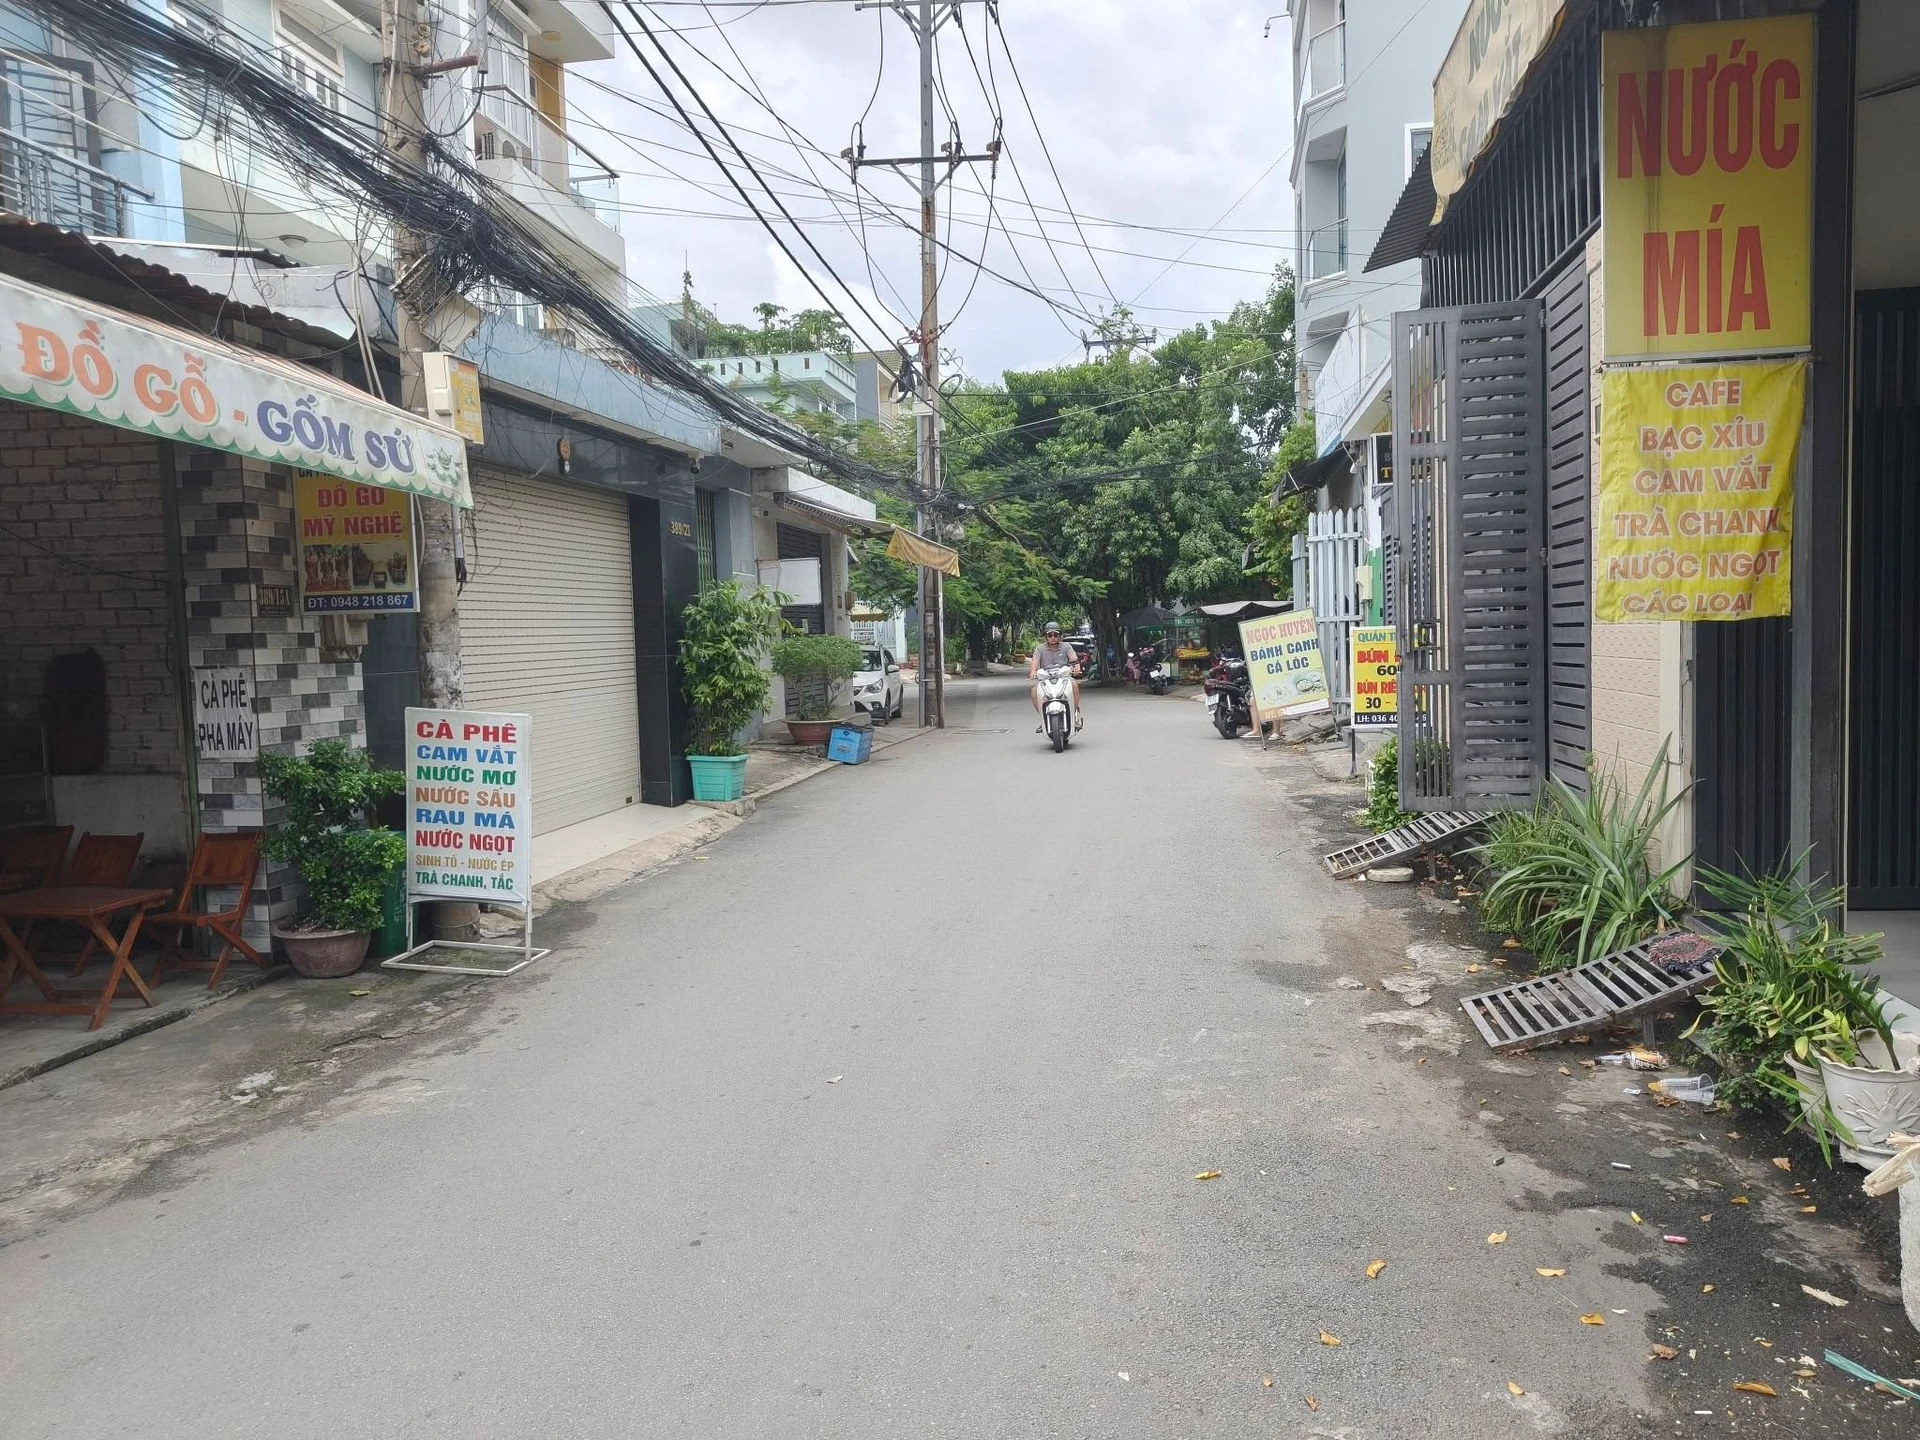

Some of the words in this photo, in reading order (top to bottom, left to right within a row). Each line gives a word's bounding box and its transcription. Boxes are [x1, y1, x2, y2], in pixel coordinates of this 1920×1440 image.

[1617, 39, 1800, 179] NƯỚC
[1643, 204, 1771, 338] MÍA
[16, 319, 115, 397] ĐỒ
[134, 352, 217, 424] GỖ
[257, 394, 355, 461] GỐM
[365, 427, 415, 473] SỨ
[1666, 380, 1741, 407] CAFE
[1641, 426, 1703, 458] BẠC
[1712, 416, 1766, 449] XỈU
[1634, 468, 1704, 494] CAM
[1714, 455, 1772, 491] VẮT
[317, 482, 348, 508] ĐỒ
[304, 514, 336, 537] MỸ
[343, 511, 403, 538] NGHỆ
[1614, 506, 1670, 537] TRÀ
[1679, 508, 1780, 536] CHANH
[1609, 548, 1698, 580] NƯỚC
[1708, 550, 1781, 582] NGỌT
[308, 598, 327, 609] ĐT:
[331, 596, 359, 608] 0948
[363, 595, 384, 607] 218
[387, 594, 408, 606] 867
[1623, 590, 1687, 613] CÁC
[1696, 592, 1753, 617] LOẠI
[1246, 625, 1276, 644] NGỌC
[1358, 630, 1386, 642] QUÁN
[1250, 646, 1283, 661] BÁNH
[1287, 638, 1320, 654] CANH
[1357, 648, 1389, 663] BÚN
[1267, 660, 1283, 675] CÁ
[1286, 656, 1309, 671] LÓC
[200, 673, 220, 709] CÀ
[221, 672, 248, 707] PHÊ
[1356, 679, 1378, 694] BÚN
[1380, 678, 1397, 694] RIÊ
[1365, 697, 1382, 709] 30
[1357, 714, 1370, 723] LH:
[1372, 714, 1387, 722] 036
[198, 723, 227, 751] PHA
[227, 717, 254, 751] MÁY
[416, 719, 454, 740] CÀ
[463, 723, 517, 743] PHÊ
[416, 745, 468, 762] CAM
[475, 745, 517, 765] VẮT
[416, 765, 474, 783] NƯỚC
[482, 769, 517, 785] MƠ
[415, 786, 470, 805] NƯỚC
[476, 787, 516, 808] SẤU
[415, 808, 465, 826] RAU
[474, 811, 516, 829] MÁ
[415, 828, 464, 849] NƯỚC
[469, 834, 516, 855] NGỌT
[415, 854, 441, 867] SINH
[444, 855, 457, 868] TỐ
[468, 857, 498, 871] NƯỚC
[501, 857, 515, 872] ÉP
[415, 870, 438, 885] TRÀ
[442, 873, 487, 889] CHANH,
[491, 872, 514, 890] TẮC
